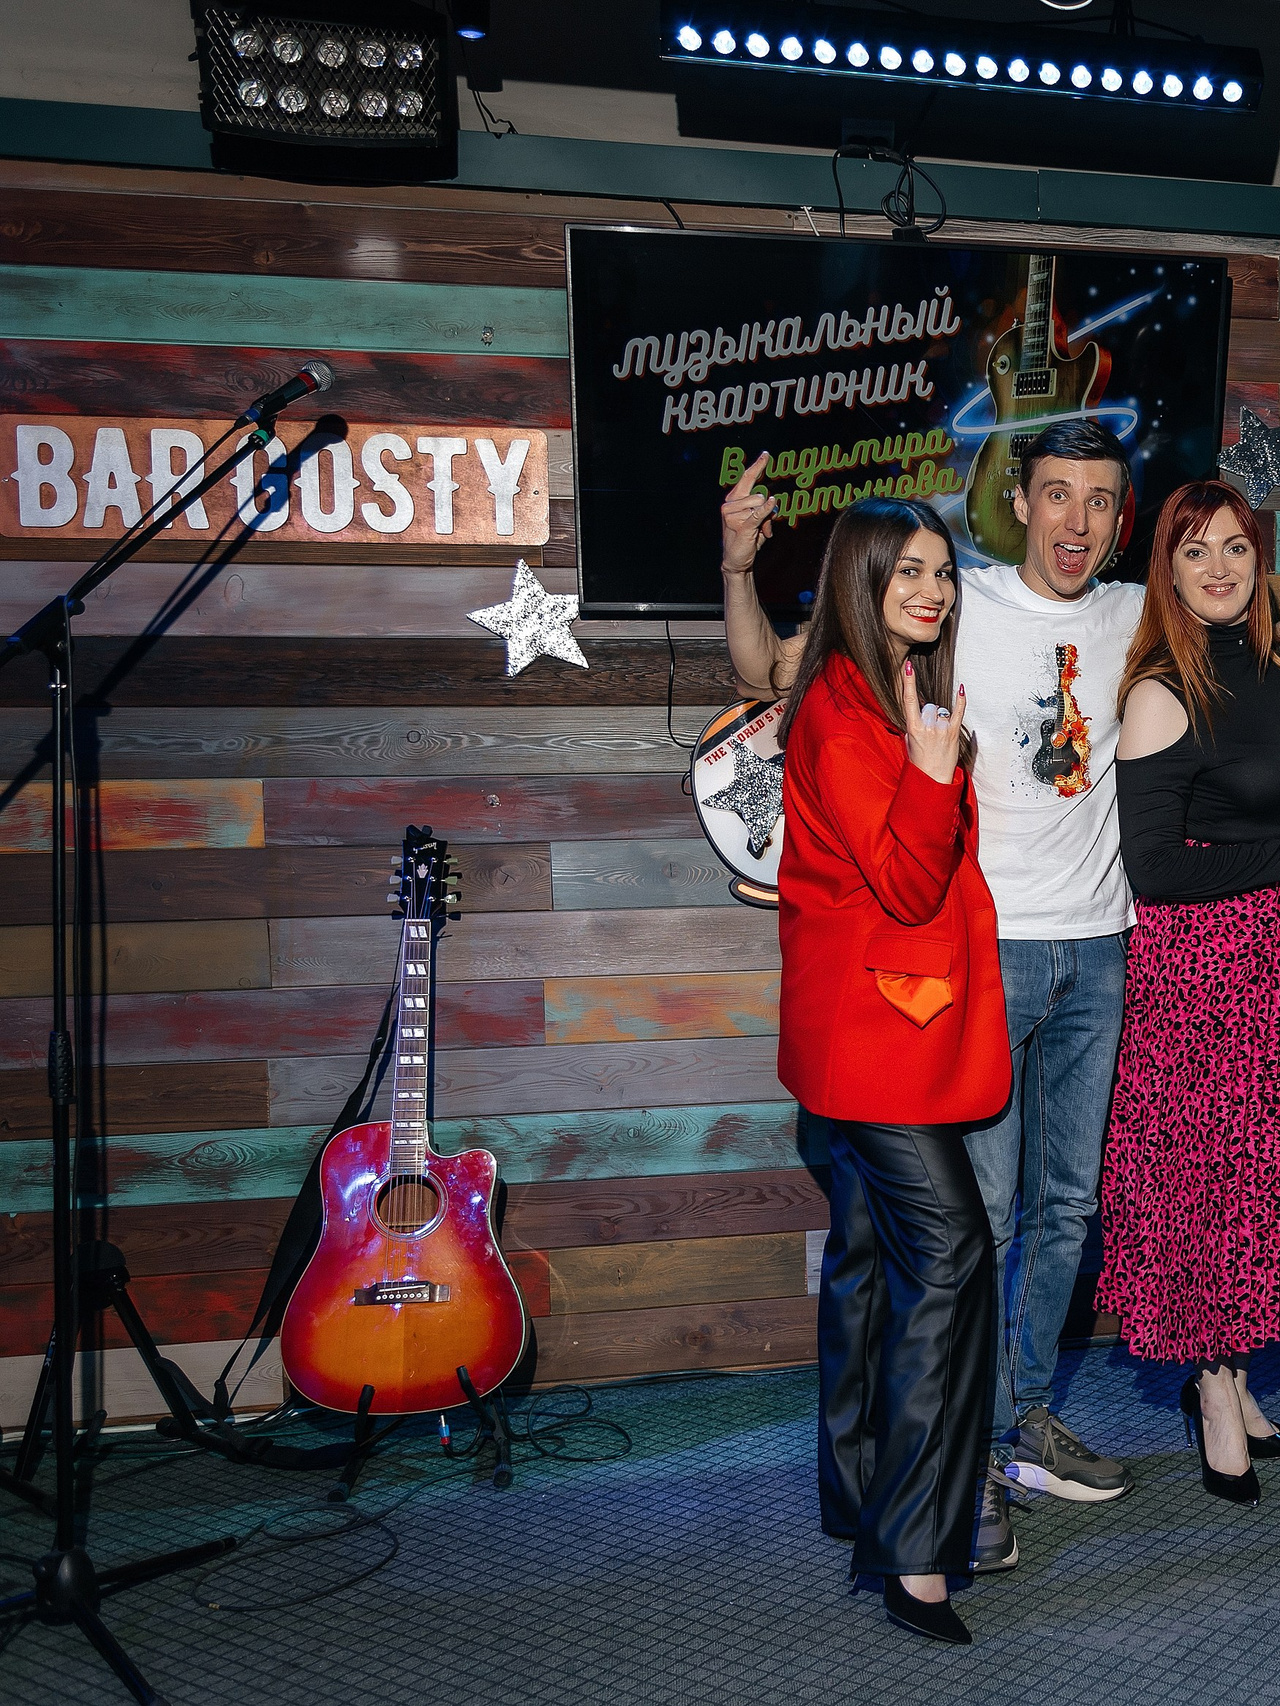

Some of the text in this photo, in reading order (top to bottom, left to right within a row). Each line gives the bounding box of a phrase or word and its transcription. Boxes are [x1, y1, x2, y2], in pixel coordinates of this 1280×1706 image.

[10, 424, 532, 536] BAR GOSTY
[751, 460, 965, 527] артынова
[704, 746, 728, 766] THE
